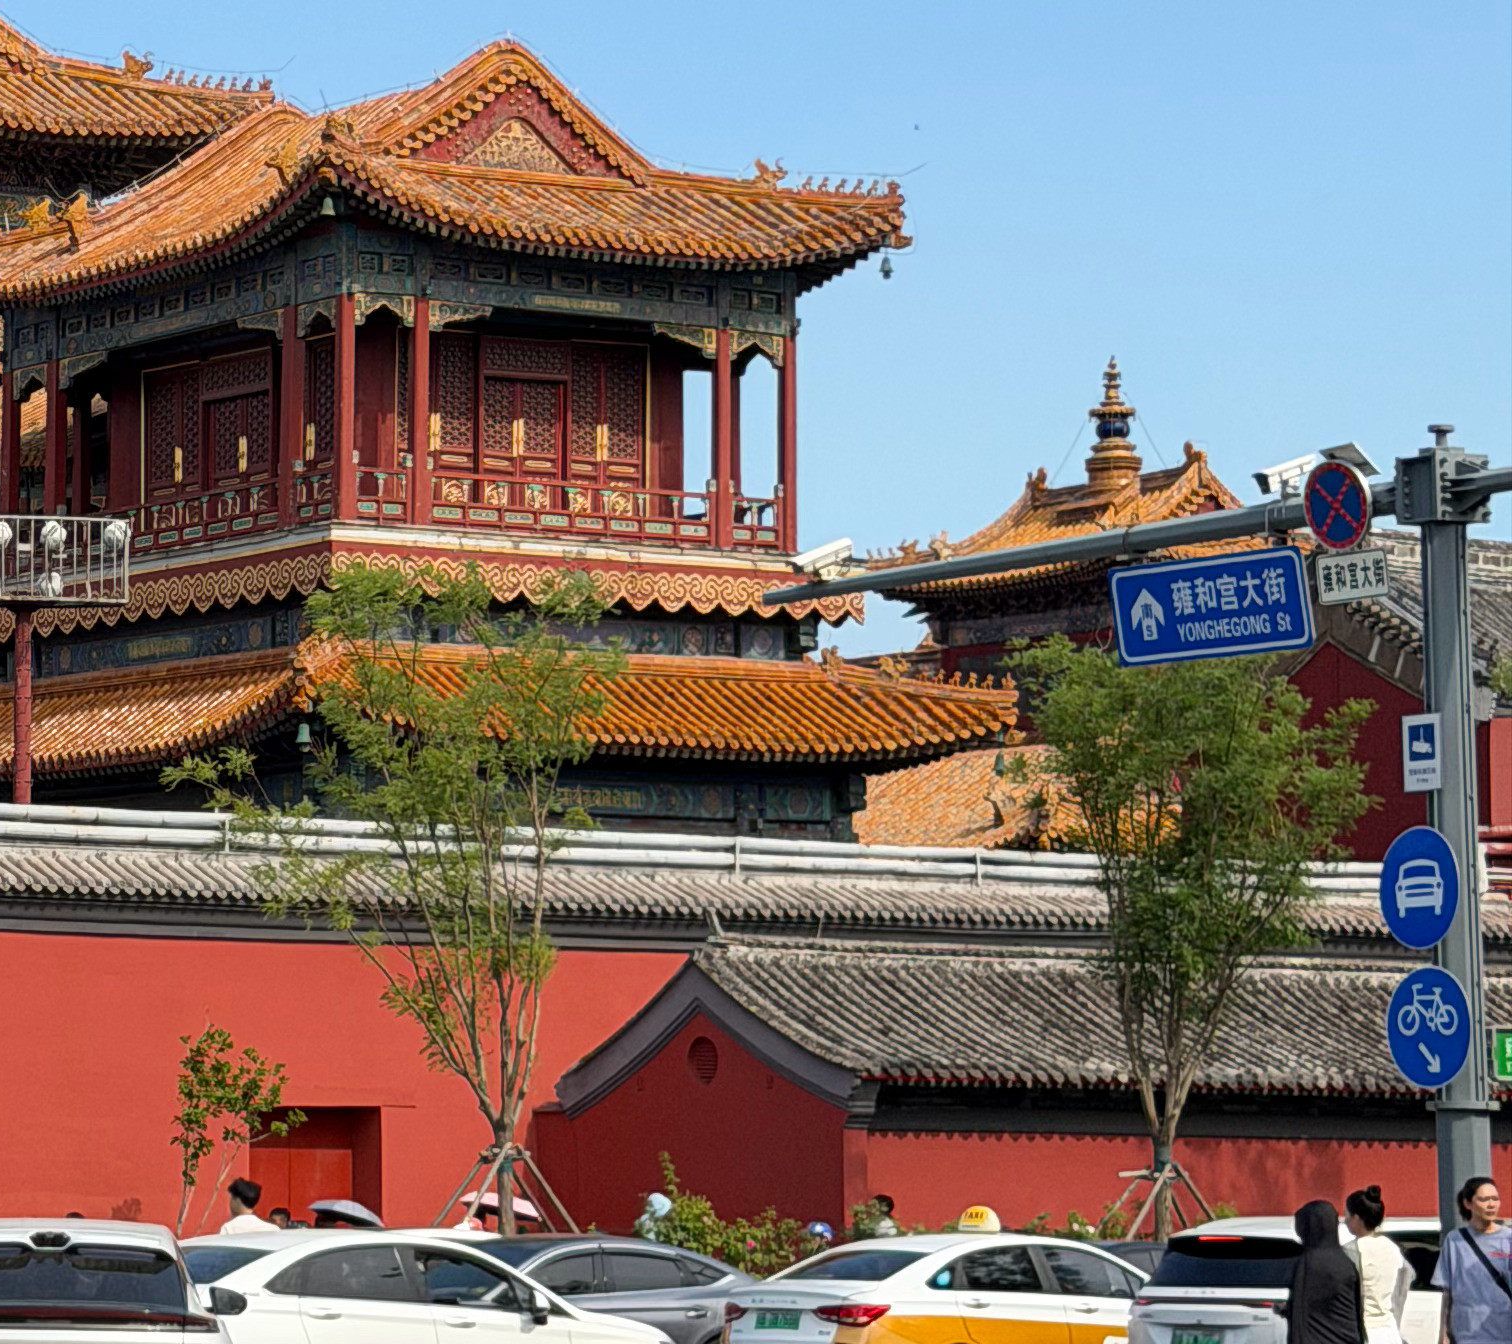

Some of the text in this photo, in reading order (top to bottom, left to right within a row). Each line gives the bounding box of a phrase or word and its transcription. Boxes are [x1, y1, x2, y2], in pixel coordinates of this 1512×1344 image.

[1170, 567, 1287, 616] 雍和宫大街
[1321, 558, 1385, 593] 雍和宫大街
[1145, 626, 1154, 638] S
[1176, 612, 1292, 643] YONGHEGONG St
